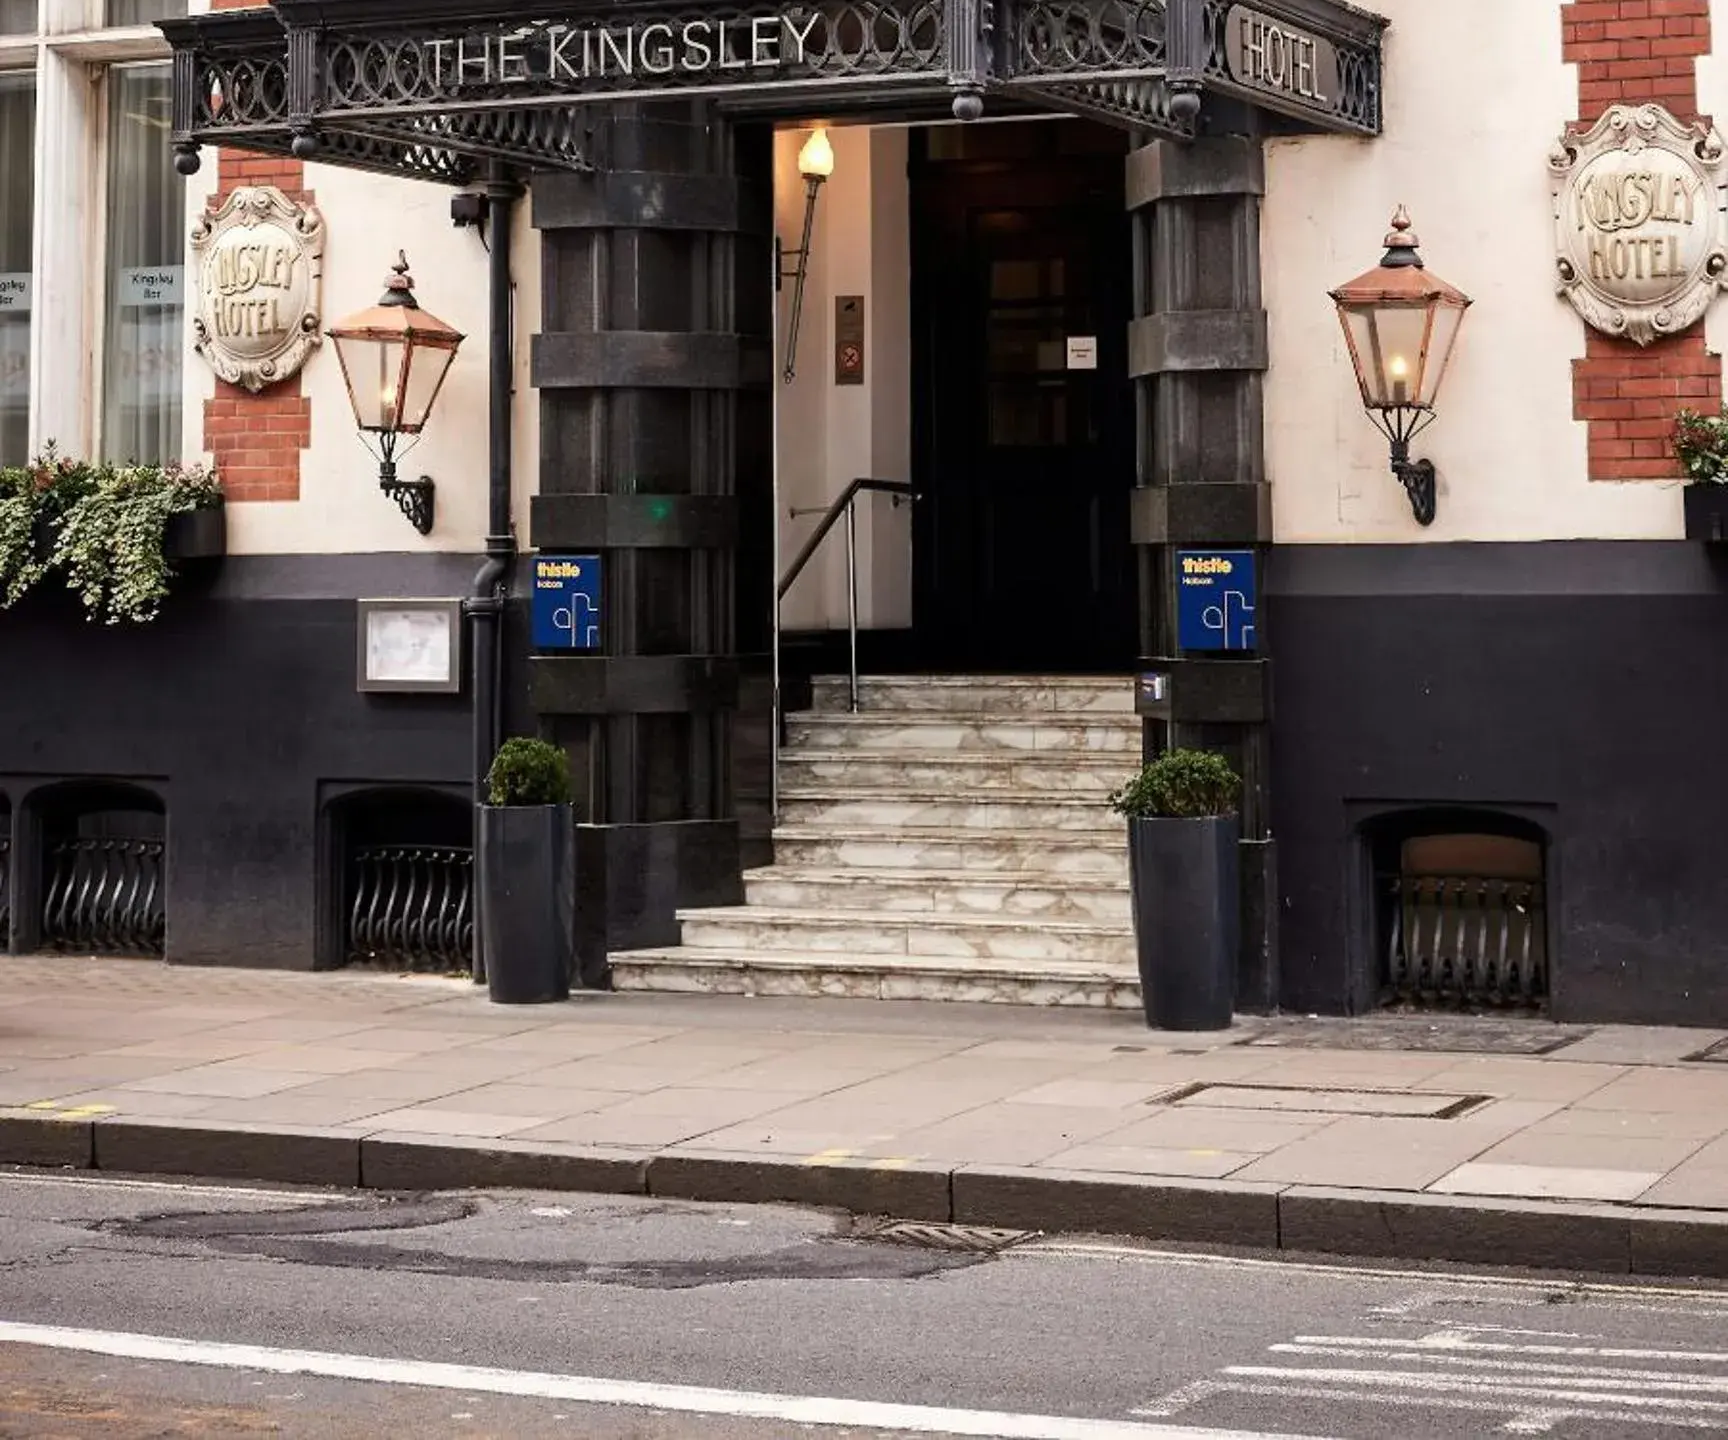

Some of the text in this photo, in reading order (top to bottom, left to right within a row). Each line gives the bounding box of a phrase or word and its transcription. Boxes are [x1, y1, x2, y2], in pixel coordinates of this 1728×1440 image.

[423, 11, 819, 86] THE KINGSLEY
[1245, 17, 1327, 102] HOTEL
[204, 242, 302, 297] KINGSLEY
[1587, 233, 1688, 280] HOTEL
[213, 297, 288, 337] HOTEL
[537, 561, 580, 577] thistle
[1182, 557, 1232, 574] thistle
